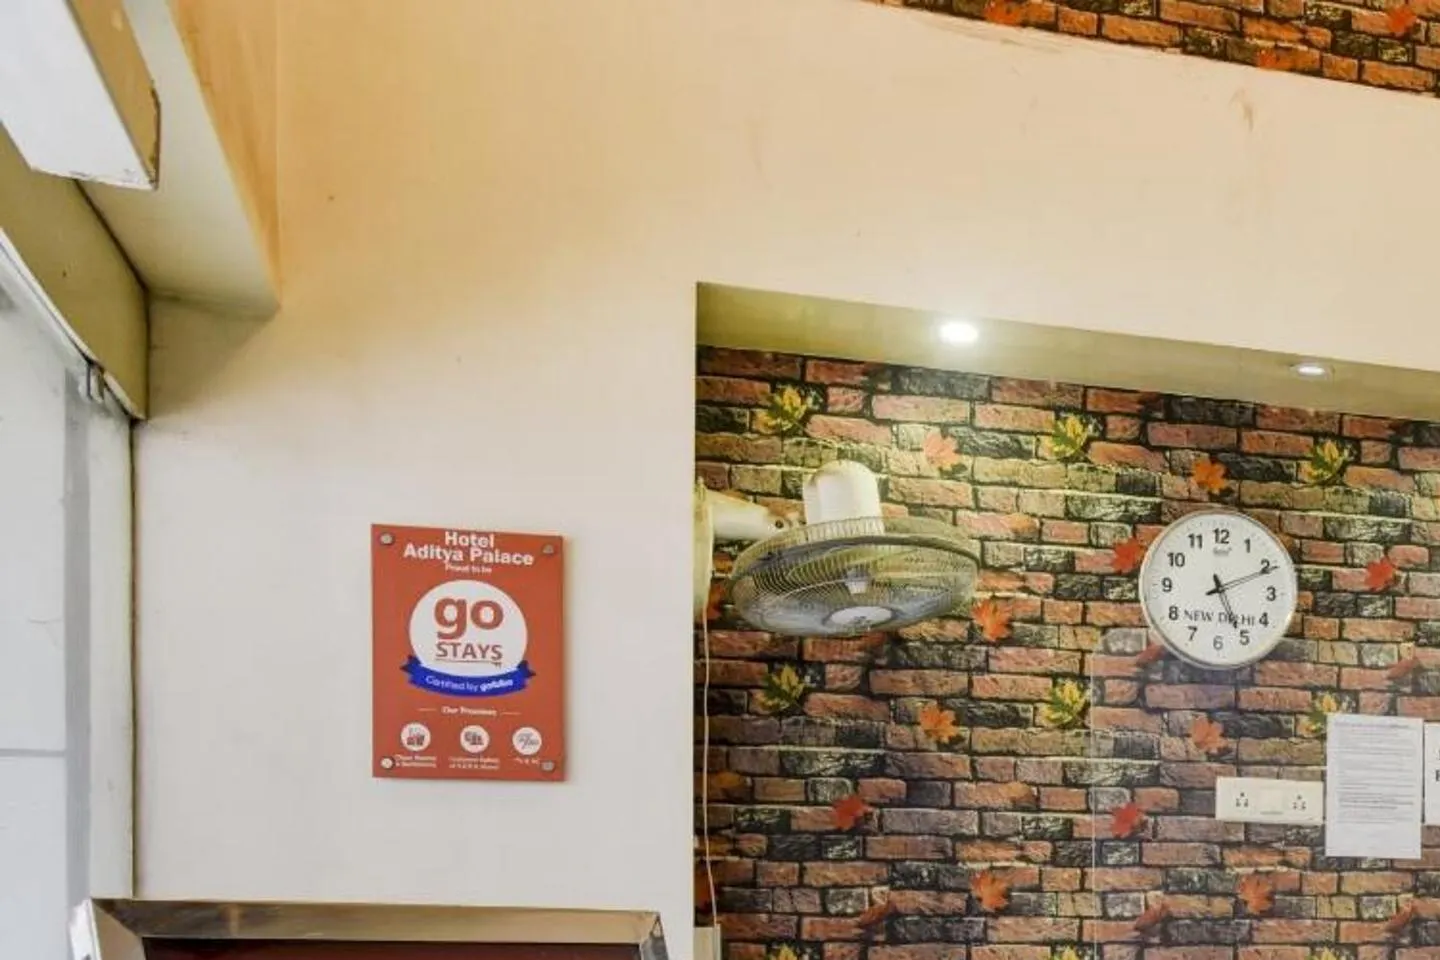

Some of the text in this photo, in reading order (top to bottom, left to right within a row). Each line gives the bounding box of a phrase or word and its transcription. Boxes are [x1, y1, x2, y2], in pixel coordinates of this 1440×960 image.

[445, 531, 495, 548] Hotel
[1188, 533, 1203, 549] 11
[1212, 528, 1230, 545] 12
[1244, 538, 1251, 553] 1
[403, 544, 534, 566] Aditya Palace
[1167, 552, 1185, 567] 10
[1260, 559, 1271, 574] 2
[1162, 577, 1172, 592] 9
[1266, 586, 1276, 601] 3
[434, 596, 504, 640] go
[1168, 606, 1179, 621] 8
[1184, 609, 1214, 622] NEW
[1259, 612, 1269, 628] 4
[1187, 625, 1198, 641] 7
[1239, 629, 1250, 646] 5
[1213, 635, 1223, 650] 6
[435, 641, 503, 661] STAYS
